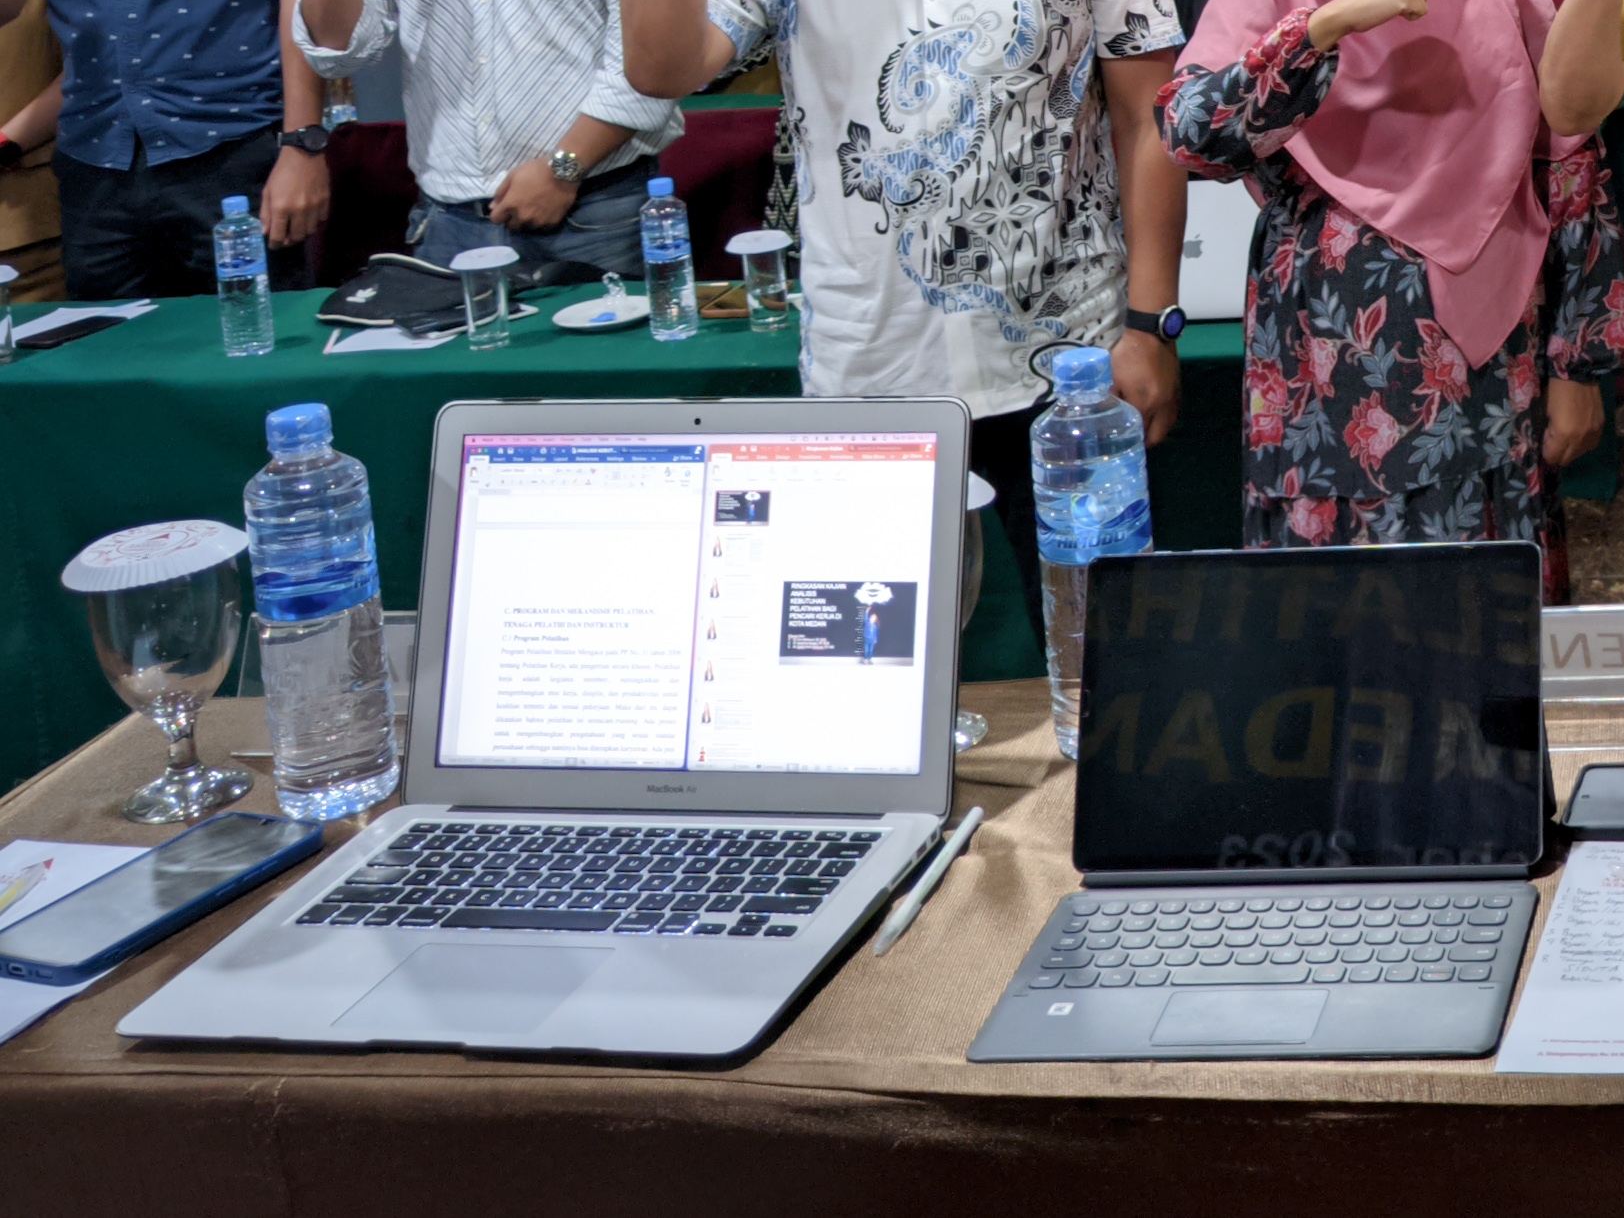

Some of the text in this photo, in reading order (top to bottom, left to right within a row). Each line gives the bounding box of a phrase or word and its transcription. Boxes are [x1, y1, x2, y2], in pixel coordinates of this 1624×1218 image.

[513, 607, 549, 615] PROGRAM
[550, 607, 566, 615] DAN
[567, 607, 611, 615] MEKANISME
[513, 634, 540, 644] Program
[541, 634, 570, 642] Pelatihan
[646, 784, 685, 793] MacBook
